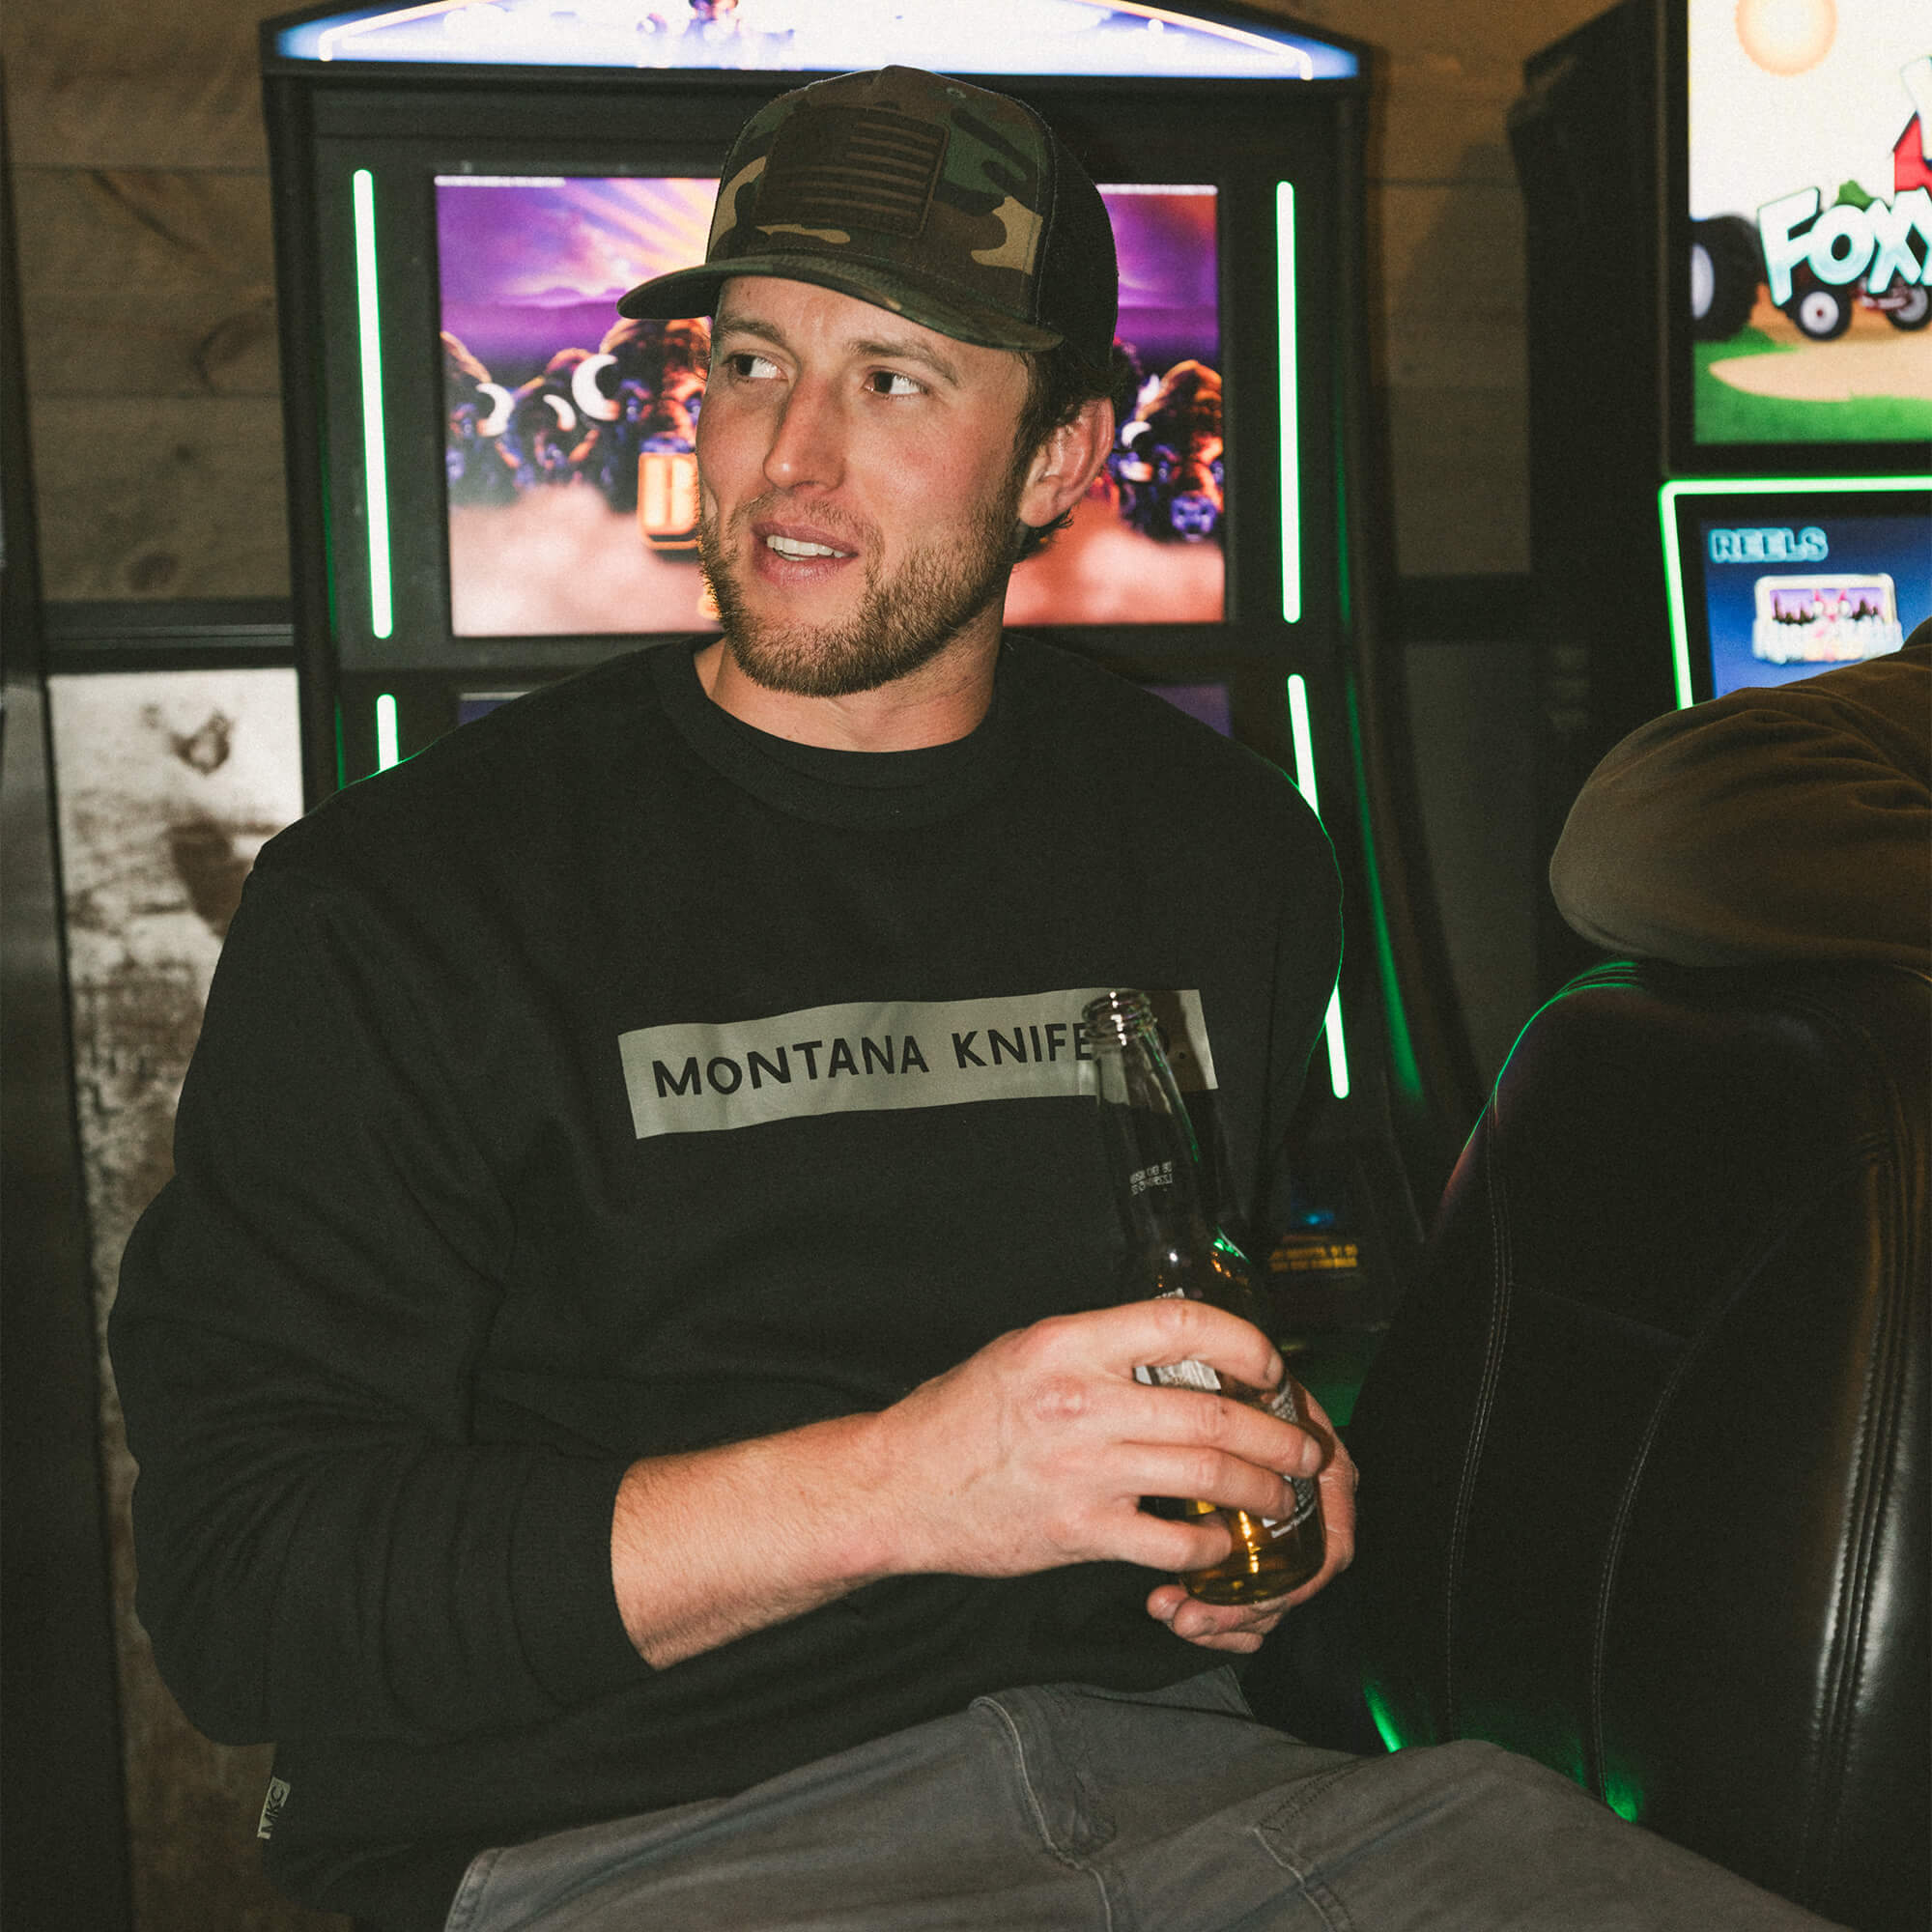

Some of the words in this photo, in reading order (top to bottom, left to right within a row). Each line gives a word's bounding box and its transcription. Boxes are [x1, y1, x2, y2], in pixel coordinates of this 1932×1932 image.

[1709, 527, 1829, 563] REELS
[652, 1035, 930, 1098] MONTANA
[952, 1022, 1094, 1068] KNIFE
